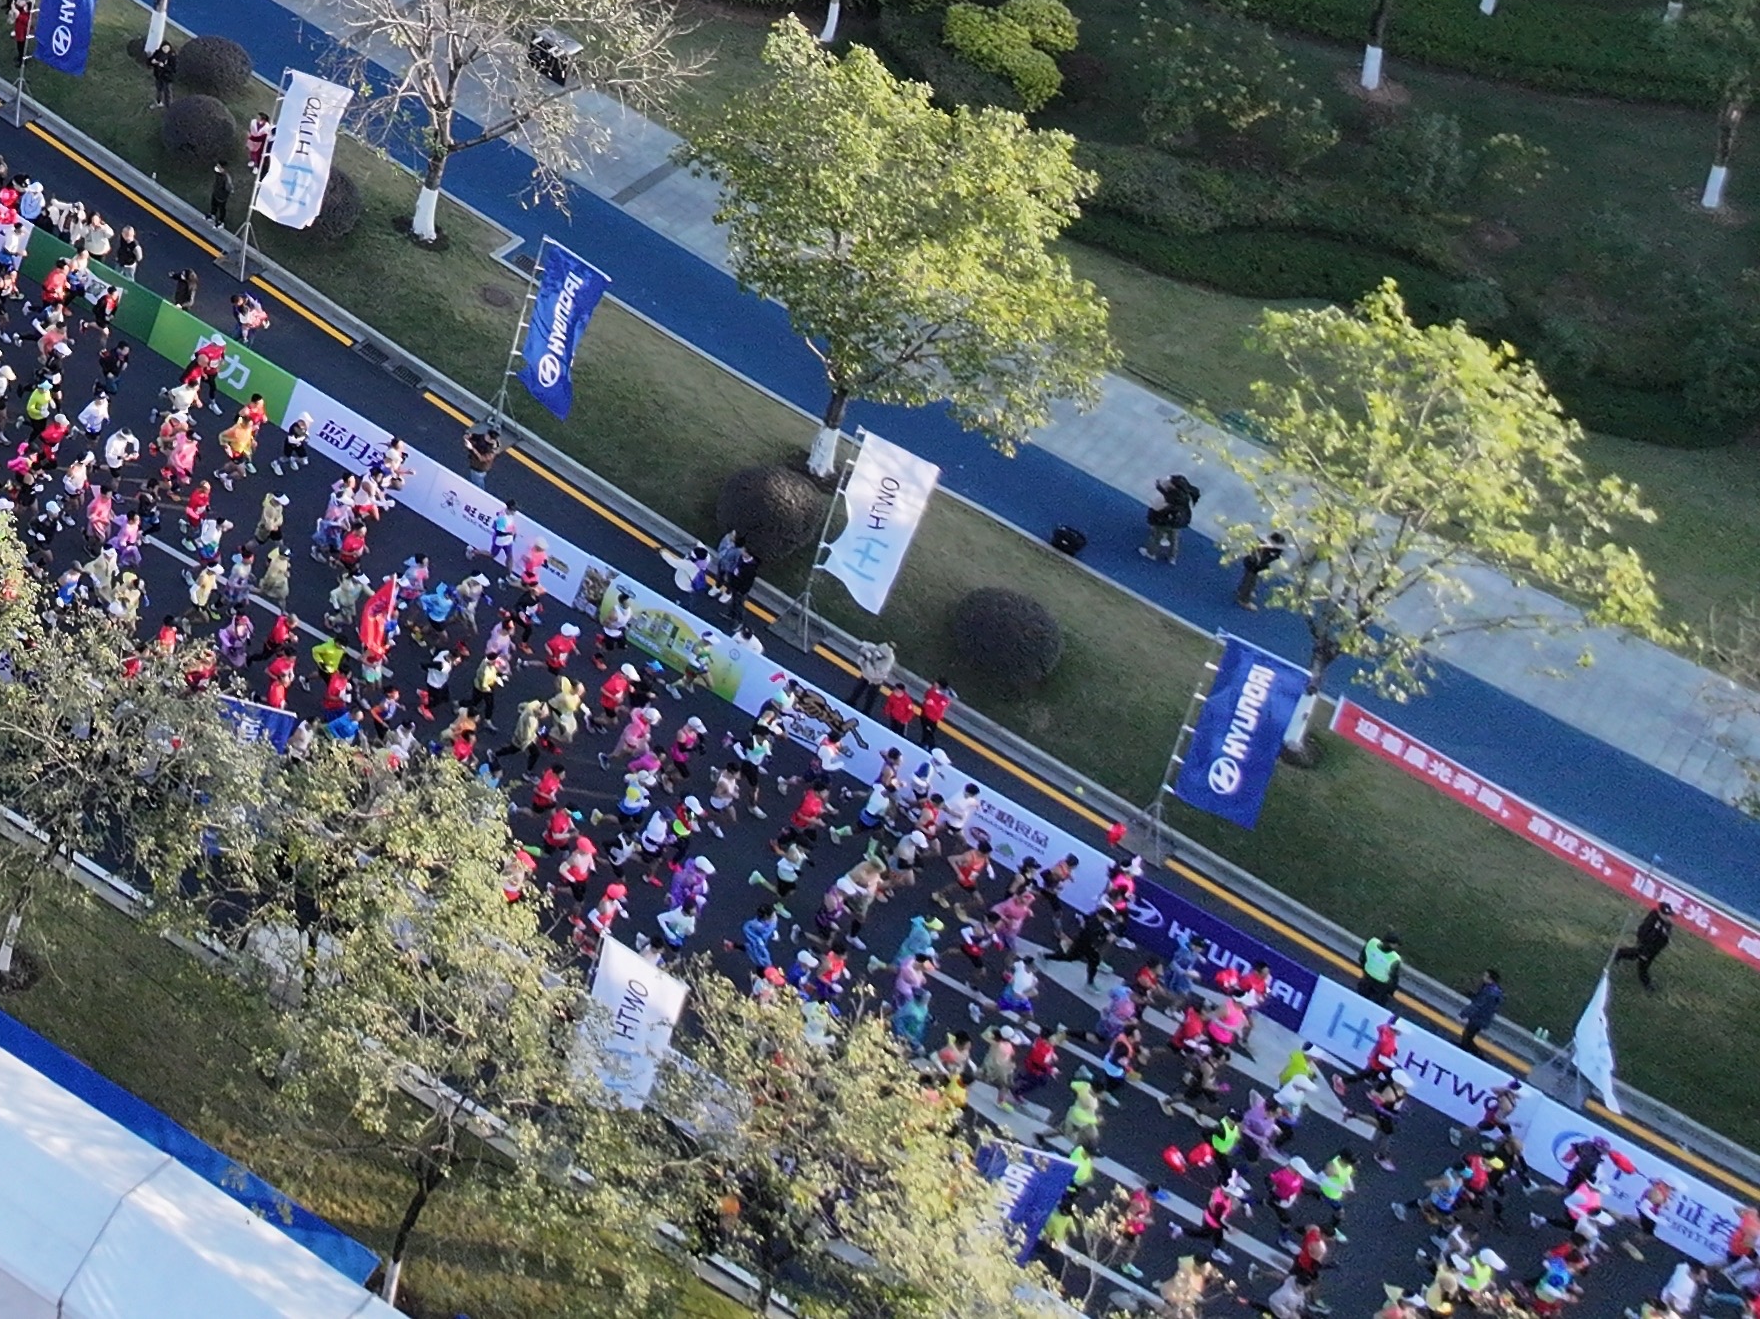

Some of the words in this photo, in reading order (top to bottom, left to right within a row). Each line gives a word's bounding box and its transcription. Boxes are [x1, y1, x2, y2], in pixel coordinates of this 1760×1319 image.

[294, 96, 324, 157] HTWO
[547, 271, 583, 356] HYUNDAI
[463, 504, 493, 527] 旺旺
[866, 475, 901, 531] HTWO
[1221, 663, 1276, 762] HYUNDAI
[613, 977, 650, 1042] HTWO
